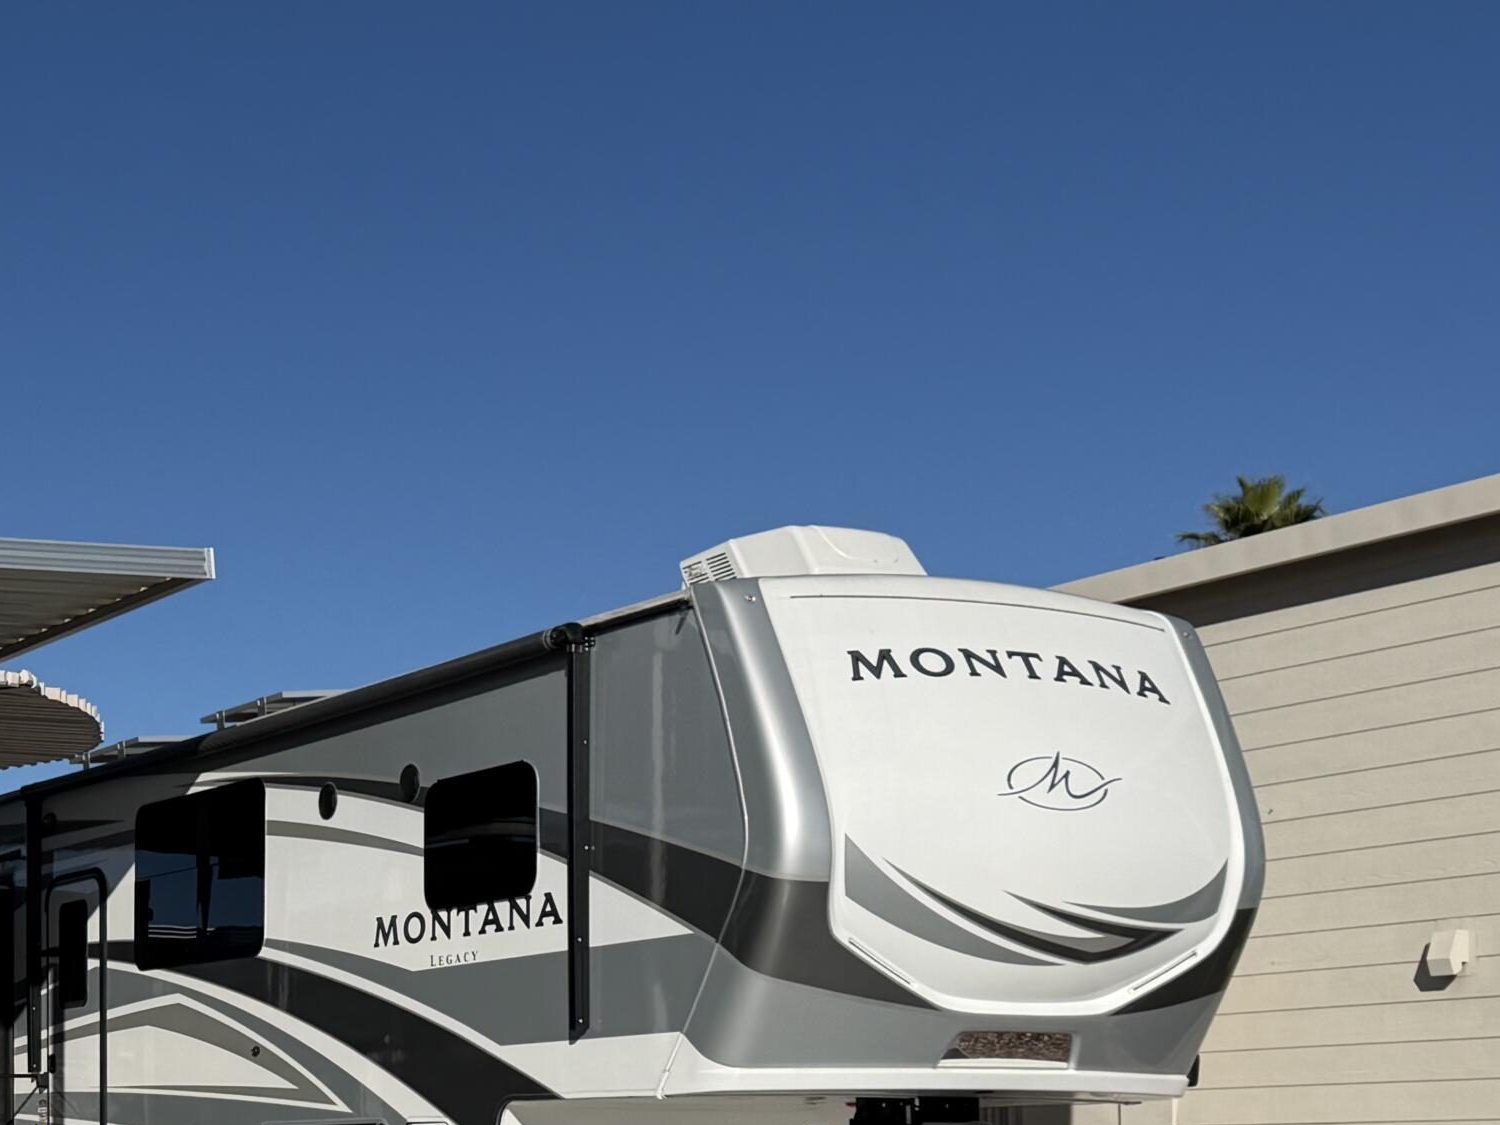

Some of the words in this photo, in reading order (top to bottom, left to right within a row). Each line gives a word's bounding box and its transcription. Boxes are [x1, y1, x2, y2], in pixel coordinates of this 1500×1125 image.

[847, 647, 1171, 705] MONTANA
[374, 892, 563, 948] MONTANA
[430, 950, 479, 967] LEGACY
